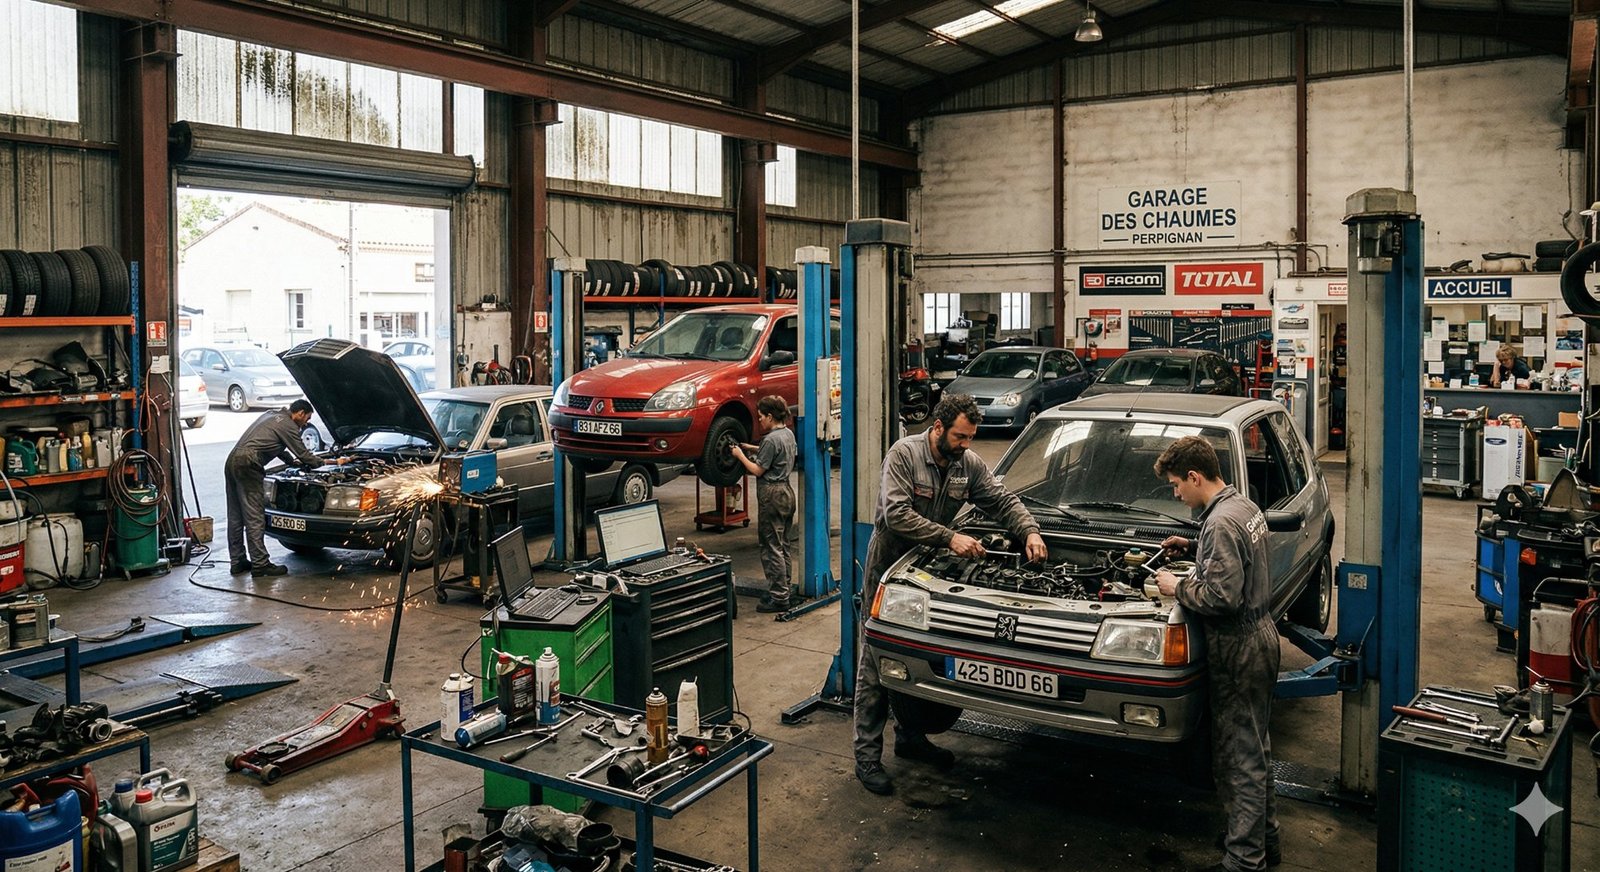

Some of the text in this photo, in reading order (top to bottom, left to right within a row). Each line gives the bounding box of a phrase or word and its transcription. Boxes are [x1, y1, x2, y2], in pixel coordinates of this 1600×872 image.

[1128, 187, 1207, 208] GARAGE
[1101, 208, 1237, 230] DES CHAUMES
[1132, 232, 1203, 244] PERPIGNAN
[1106, 275, 1160, 285] FACOM
[1181, 271, 1257, 287] TOTAL
[1432, 281, 1507, 296] ACCUEIL
[578, 421, 620, 435] 831 AFZ 66
[296, 520, 305, 530] 66
[957, 662, 1053, 694] 425 BDD 66
